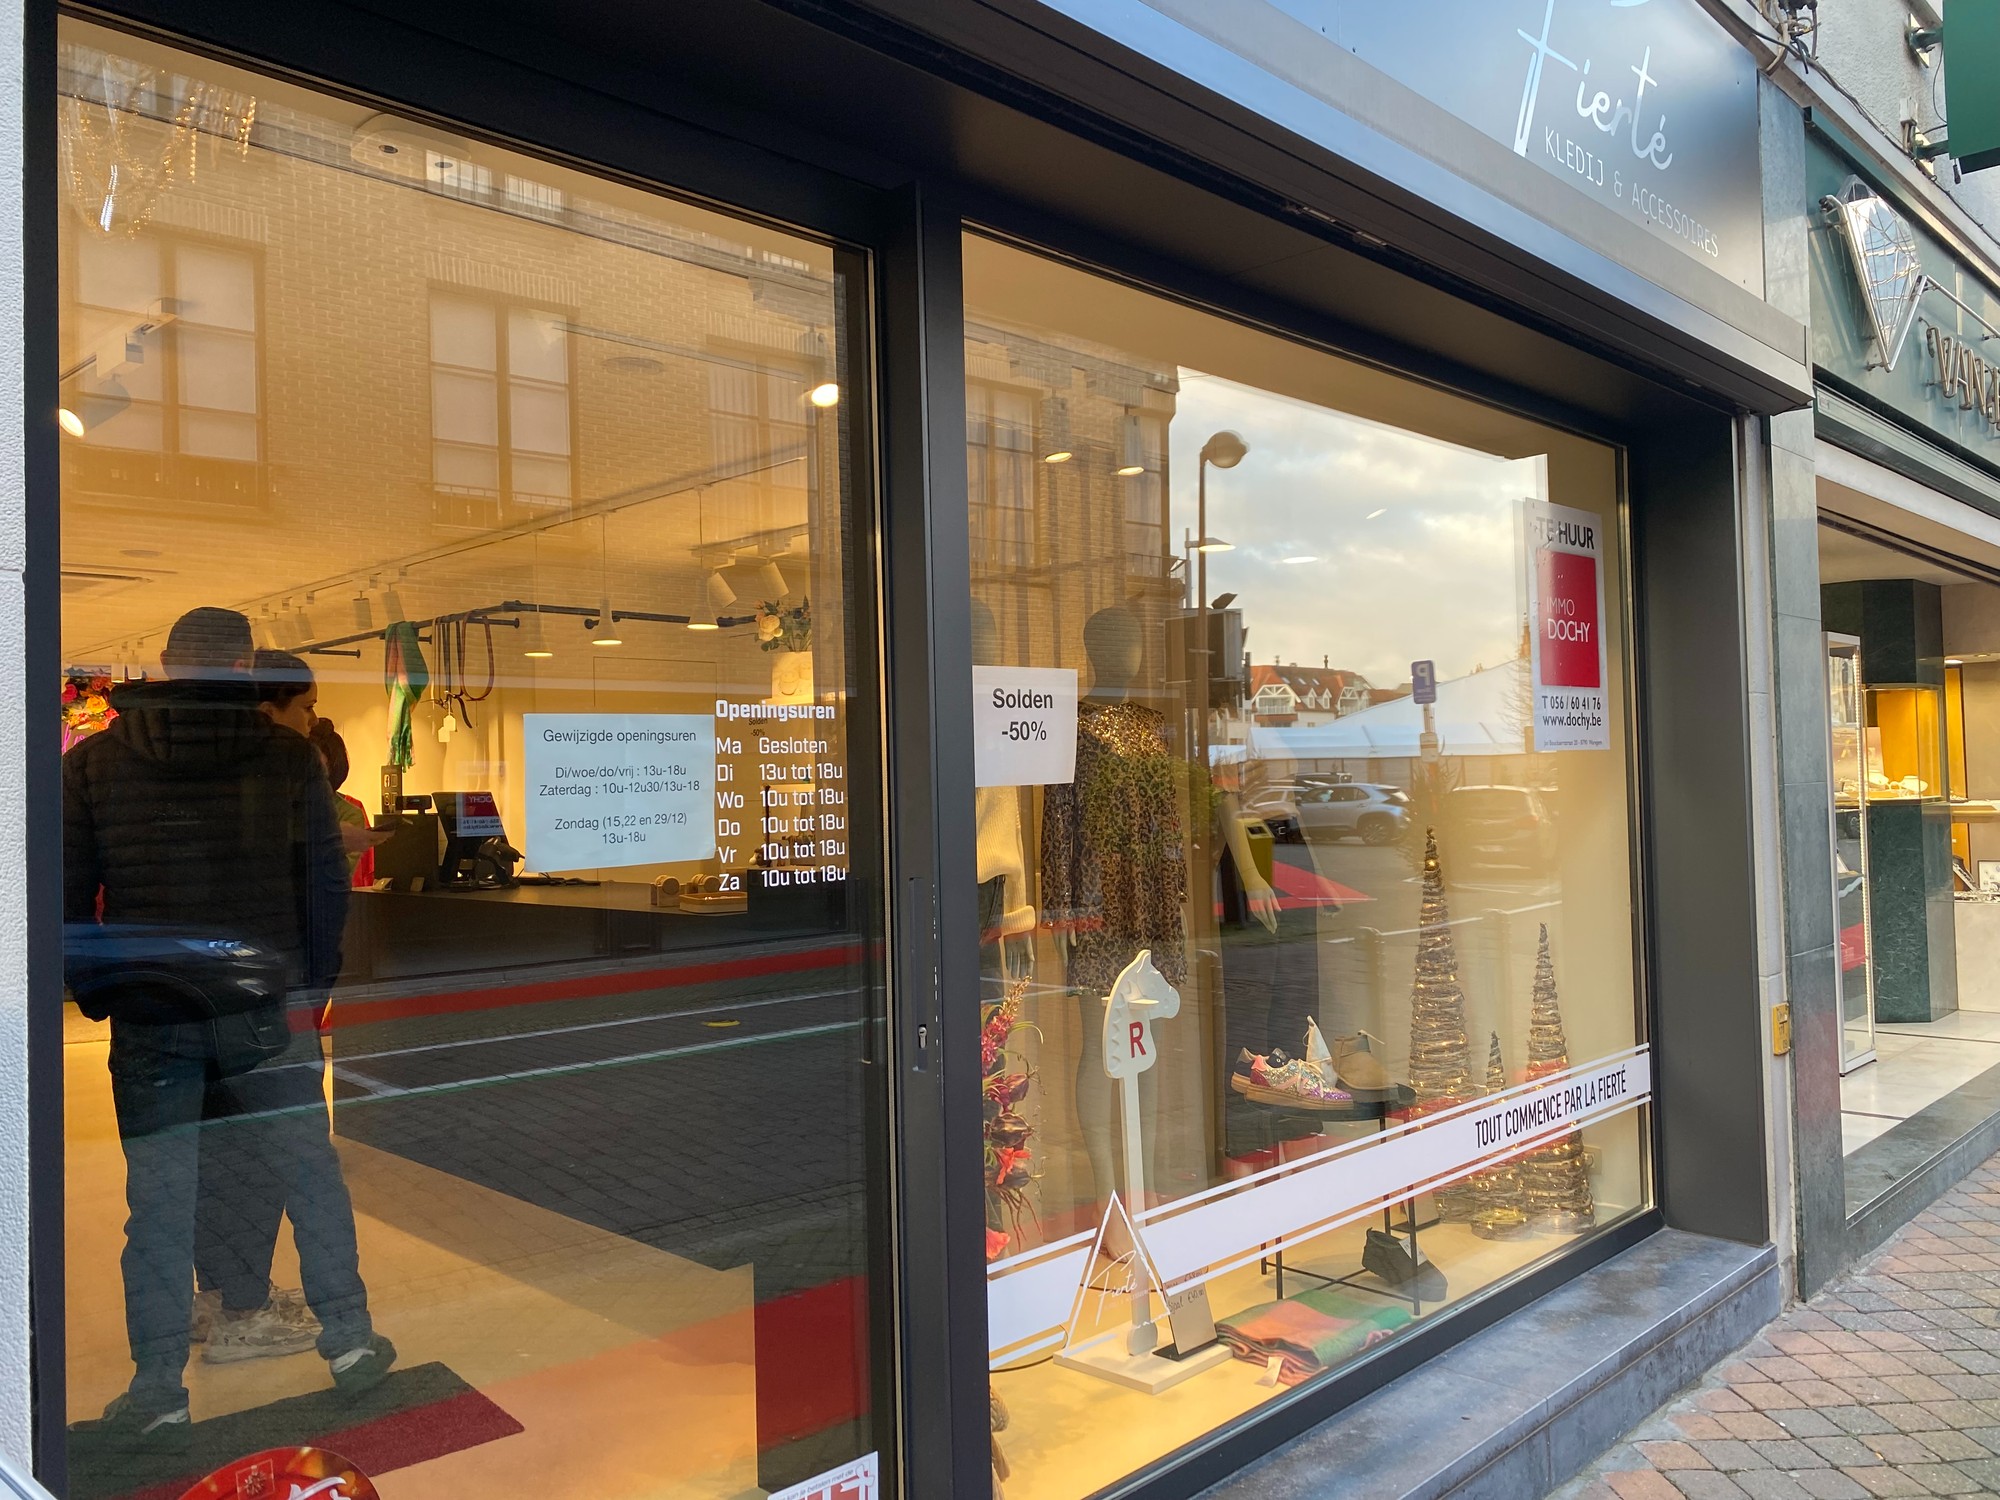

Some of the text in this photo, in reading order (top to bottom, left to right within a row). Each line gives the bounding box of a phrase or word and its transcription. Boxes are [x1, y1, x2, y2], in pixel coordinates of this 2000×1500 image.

[1545, 126, 1719, 258] KLEDIJ & ACCESSOIRES
[1536, 516, 1595, 550] TE HUUR
[1546, 596, 1575, 616] IMMO
[1547, 618, 1591, 643] DOCHY
[992, 688, 1053, 709] Solden
[1542, 696, 1548, 709] T
[1550, 696, 1564, 710] 056
[1571, 696, 1580, 710] 60
[1582, 697, 1590, 710] 41
[1593, 697, 1601, 710] 76
[715, 699, 836, 722] Openingsuren
[1001, 721, 1047, 741] -50%
[1542, 712, 1602, 731] www.dochy.be
[543, 729, 697, 745] Gewijzigde openingsuren
[716, 736, 828, 755] Ma Gesloten
[555, 765, 634, 779] Di/woe/do/vrij
[644, 764, 687, 776] 13u-18u
[717, 762, 843, 782] Di 13u tot 18u
[539, 783, 592, 797] Zaterdag
[602, 780, 700, 794] 10u-12u30/13u-18
[716, 788, 844, 809] Wo 10u tot 18u
[554, 812, 687, 831] Zondag (15,22 en 29/12)
[718, 813, 845, 837] Do 10u tot 18u
[602, 831, 646, 844] 13u-18u
[718, 839, 846, 864] Vr 10u tot 18u
[719, 865, 846, 891] Za 10u tot 18u
[1129, 1021, 1147, 1058] R
[1474, 1063, 1627, 1149] TOUT COMMENCE PAR LA FIERTÉ
